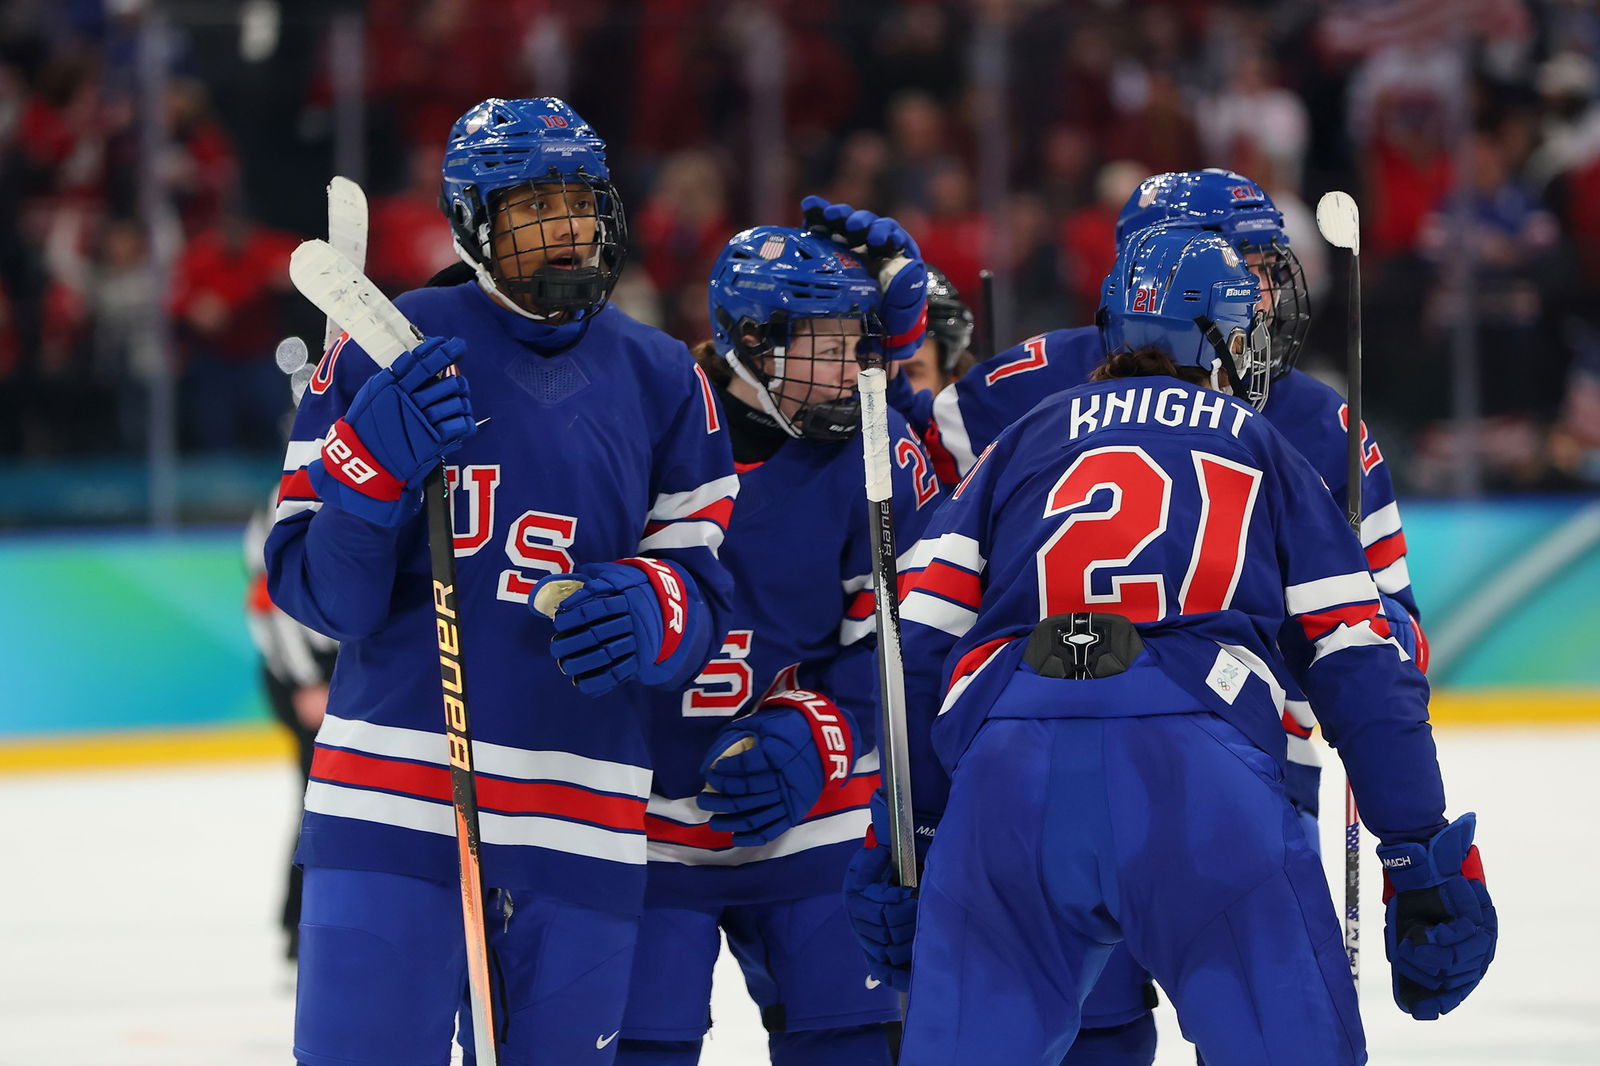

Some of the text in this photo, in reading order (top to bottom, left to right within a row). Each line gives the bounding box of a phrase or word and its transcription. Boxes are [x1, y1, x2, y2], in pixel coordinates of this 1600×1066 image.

[537, 115, 569, 128] 10
[1132, 289, 1158, 312] 21
[1225, 288, 1251, 298] BAUER
[985, 333, 1048, 387] 7
[1069, 387, 1254, 441] KNIGHT
[894, 422, 940, 512] 2
[880, 499, 893, 557] AUER
[1036, 445, 1264, 623] 21
[634, 556, 684, 634] UER
[432, 579, 471, 772] BAUER
[1383, 855, 1412, 869] MACH
